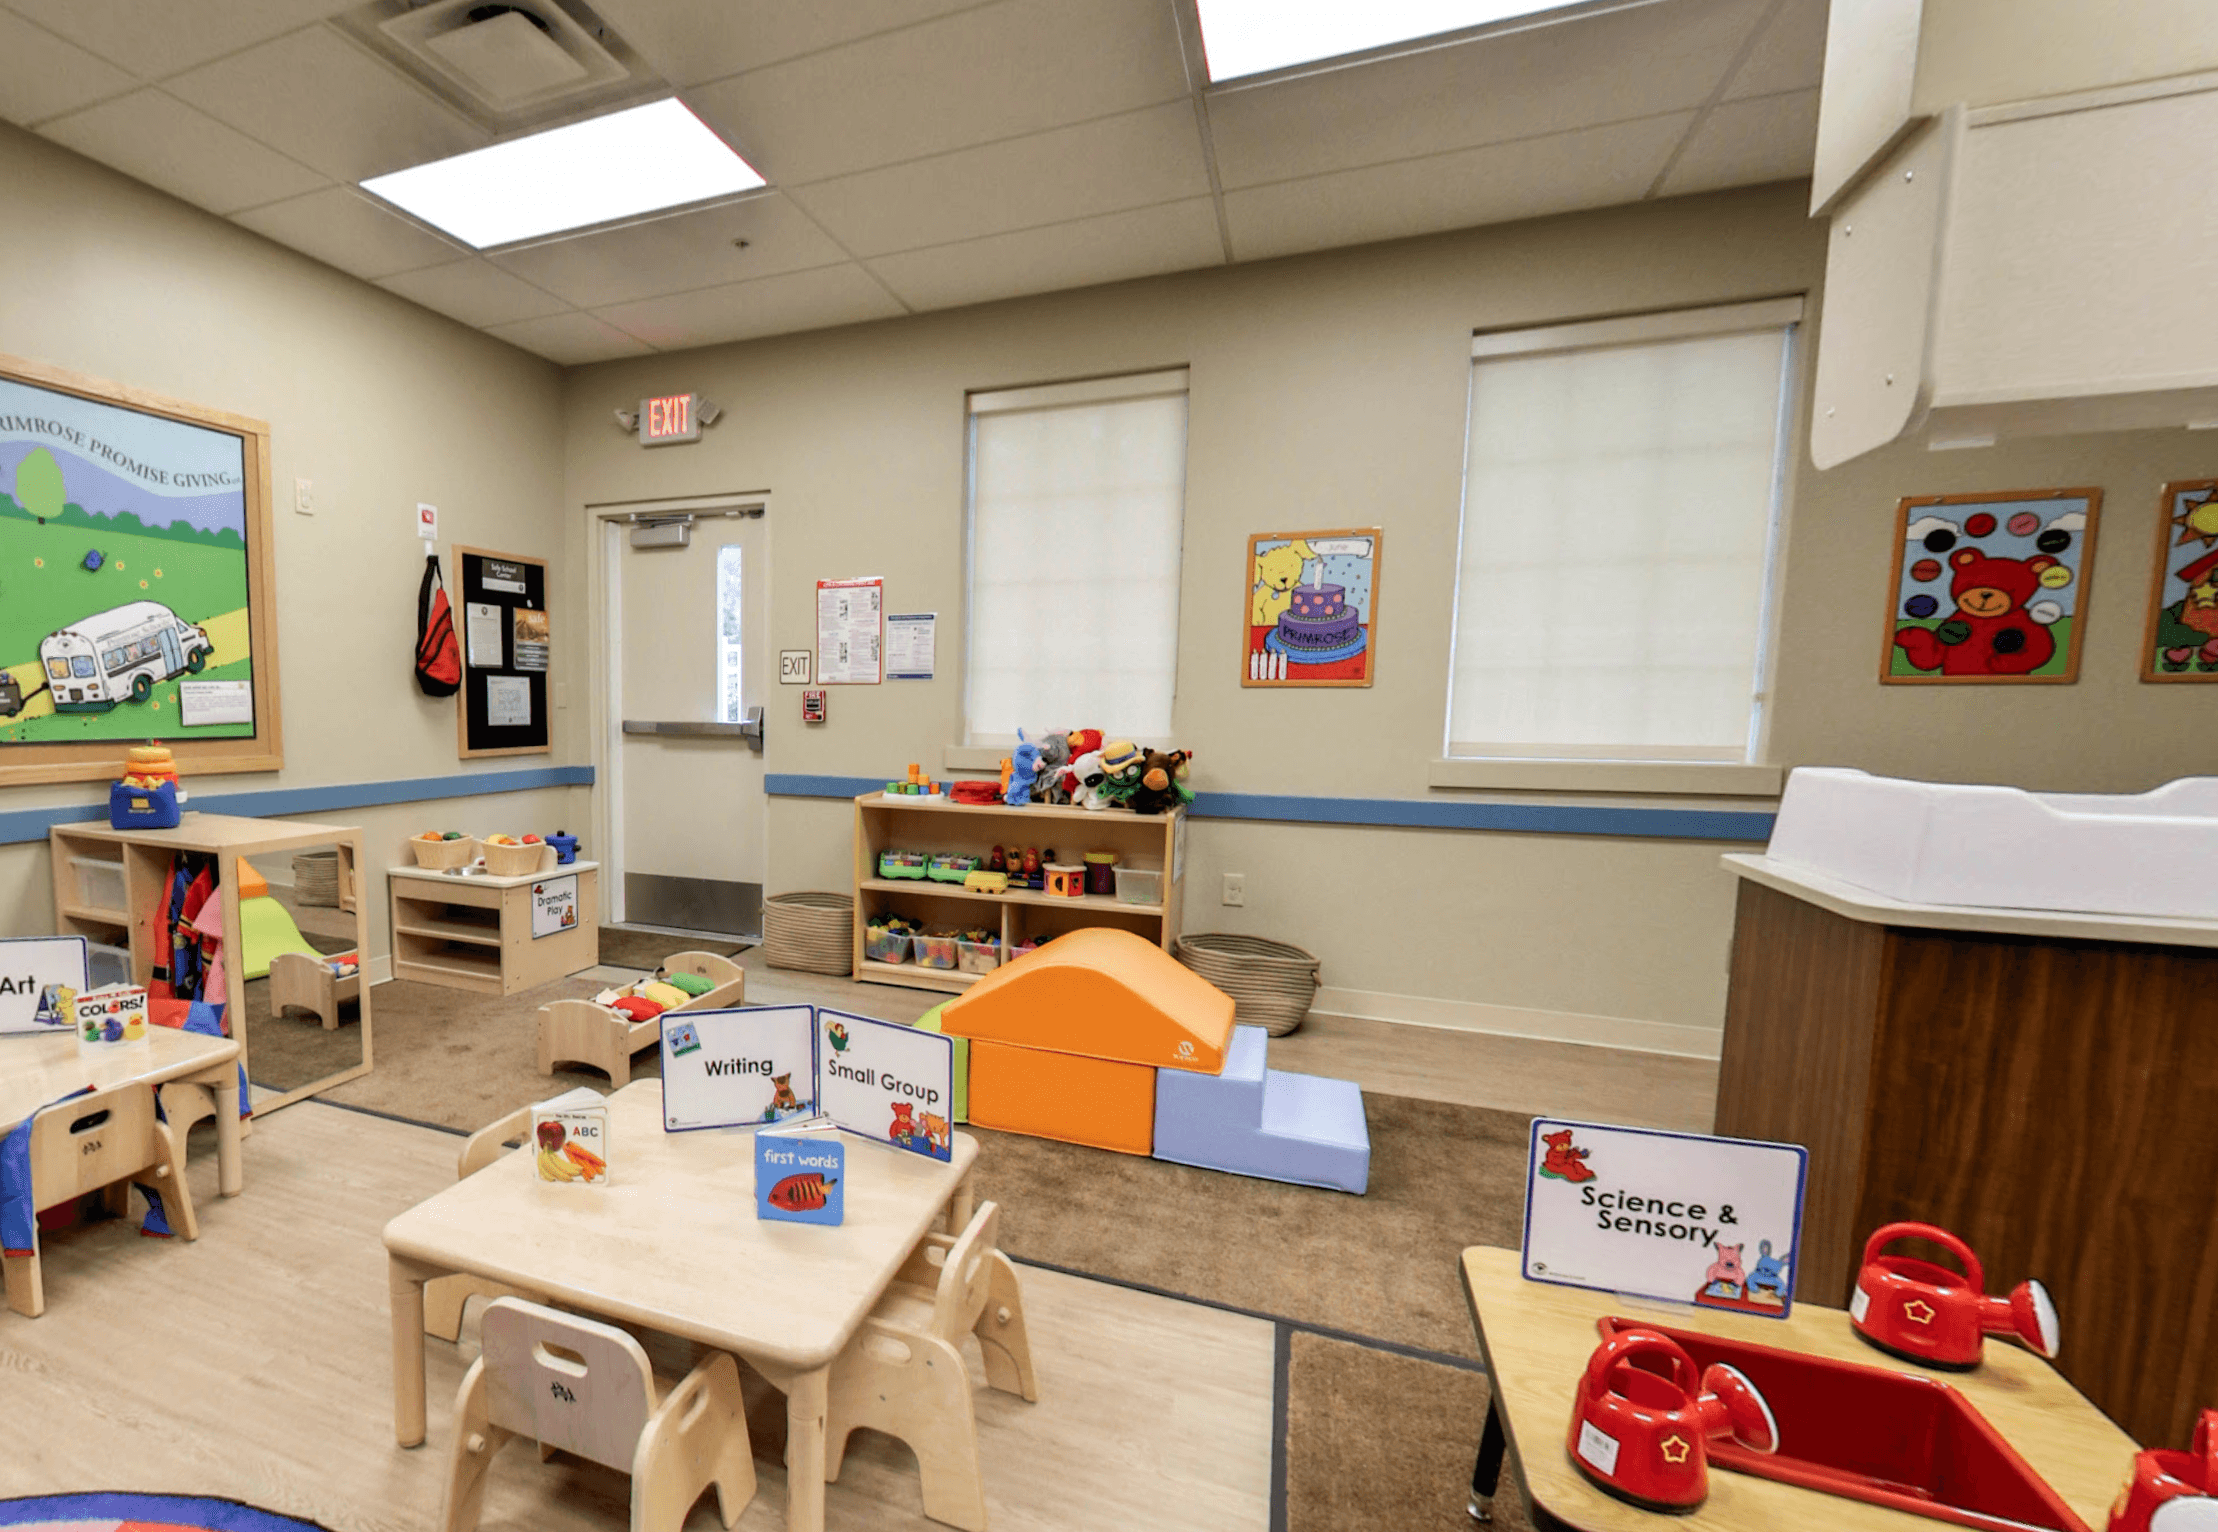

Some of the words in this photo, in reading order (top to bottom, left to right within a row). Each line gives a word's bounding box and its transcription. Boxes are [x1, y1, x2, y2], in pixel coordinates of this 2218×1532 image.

[649, 394, 691, 437] EXIT
[89, 438, 169, 485] PROMISE
[1283, 624, 1355, 645] PRIMROSE
[782, 657, 808, 675] EXIT
[538, 891, 572, 907] Dramatic
[547, 905, 563, 916] Play
[0, 975, 36, 995] Art
[704, 1058, 773, 1077] Writing
[828, 1060, 874, 1086] Small
[880, 1074, 939, 1104] Group
[573, 1126, 598, 1138] ABC
[764, 1150, 794, 1166] first
[798, 1154, 838, 1170] words
[1581, 1186, 1707, 1220] Science
[1718, 1204, 1738, 1225] &
[1597, 1210, 1718, 1247] Sensory
